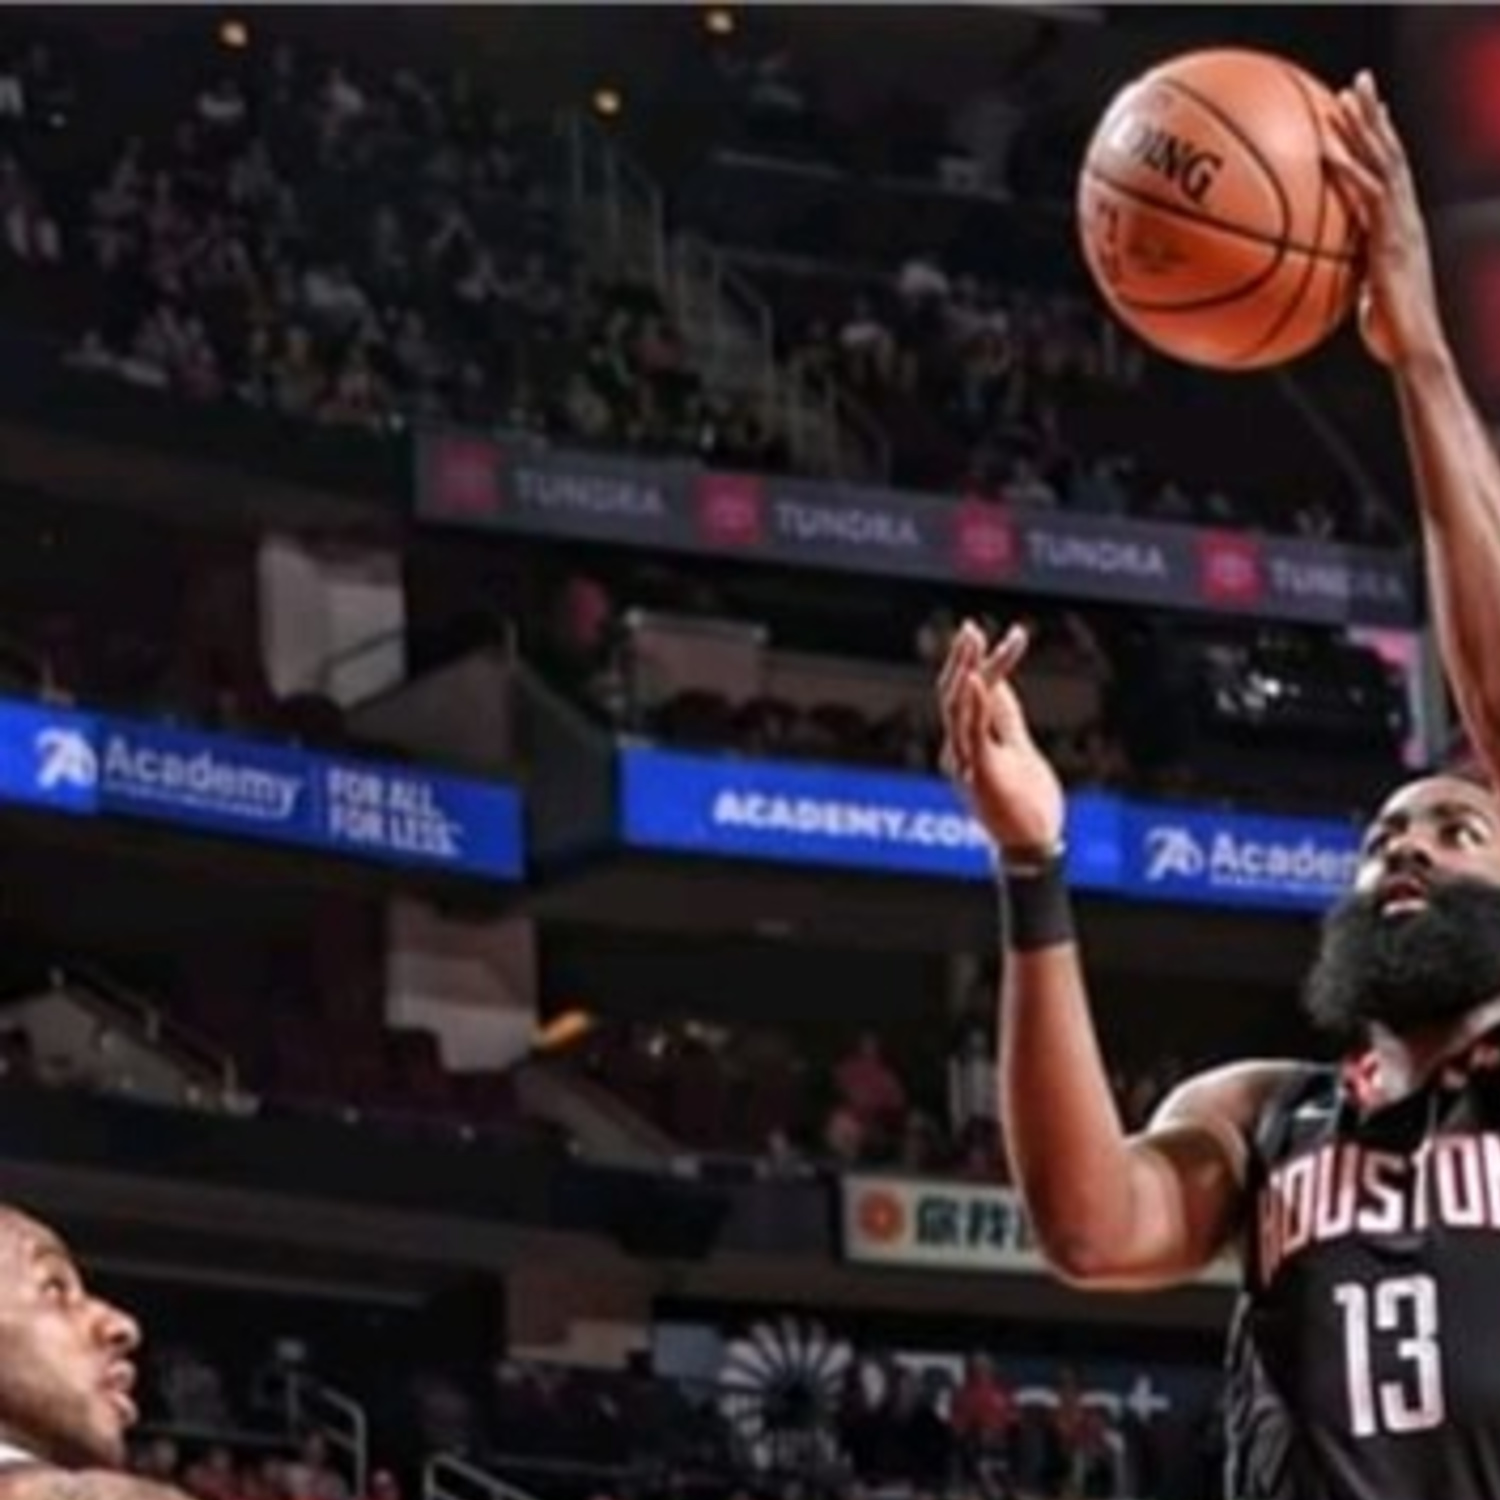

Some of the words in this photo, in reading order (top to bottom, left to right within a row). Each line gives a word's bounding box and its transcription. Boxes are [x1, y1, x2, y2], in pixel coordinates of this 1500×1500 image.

[514, 468, 664, 515] TUNDRA
[775, 501, 919, 547] TUNDRA
[1026, 532, 1167, 578] TUNDRA
[105, 738, 302, 818] Academy
[327, 766, 382, 806] FOR
[329, 806, 383, 840] FOR
[1334, 1273, 1446, 1438] 13
